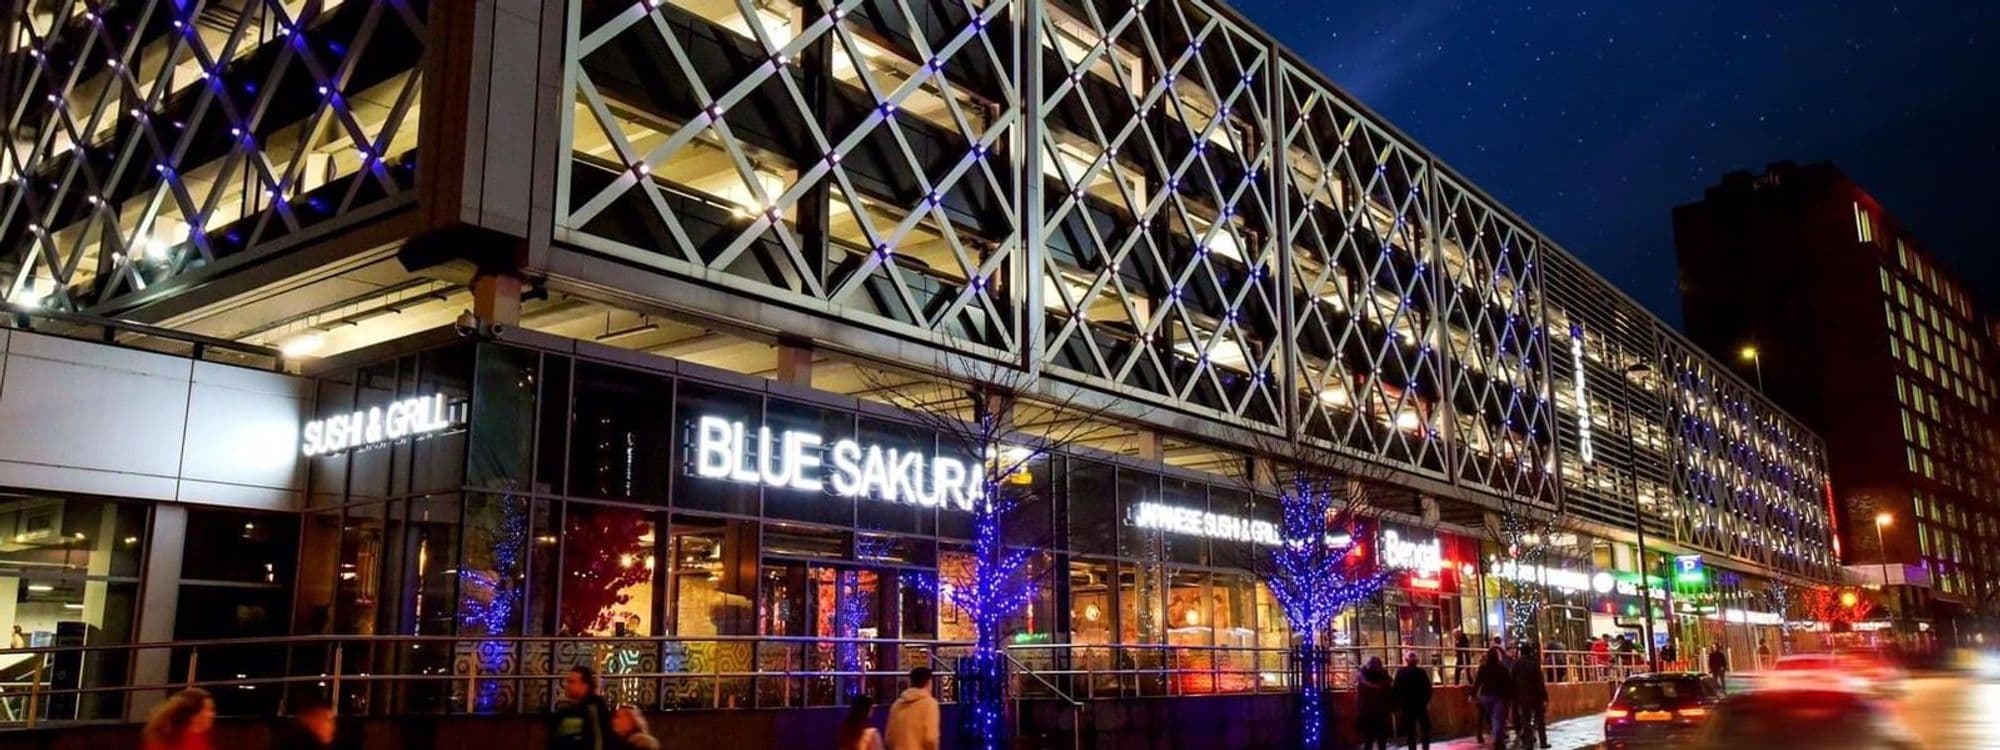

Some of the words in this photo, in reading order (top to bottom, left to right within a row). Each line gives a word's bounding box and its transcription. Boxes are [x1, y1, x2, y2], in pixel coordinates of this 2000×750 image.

[302, 411, 364, 457] SUSHI
[366, 406, 382, 443] &
[386, 393, 449, 439] GRILL
[699, 416, 823, 491] BLUE
[832, 439, 984, 511] SAKURA
[1135, 502, 1203, 535] JAPANESE
[1205, 513, 1240, 541] SUSHI
[1241, 518, 1250, 541] &
